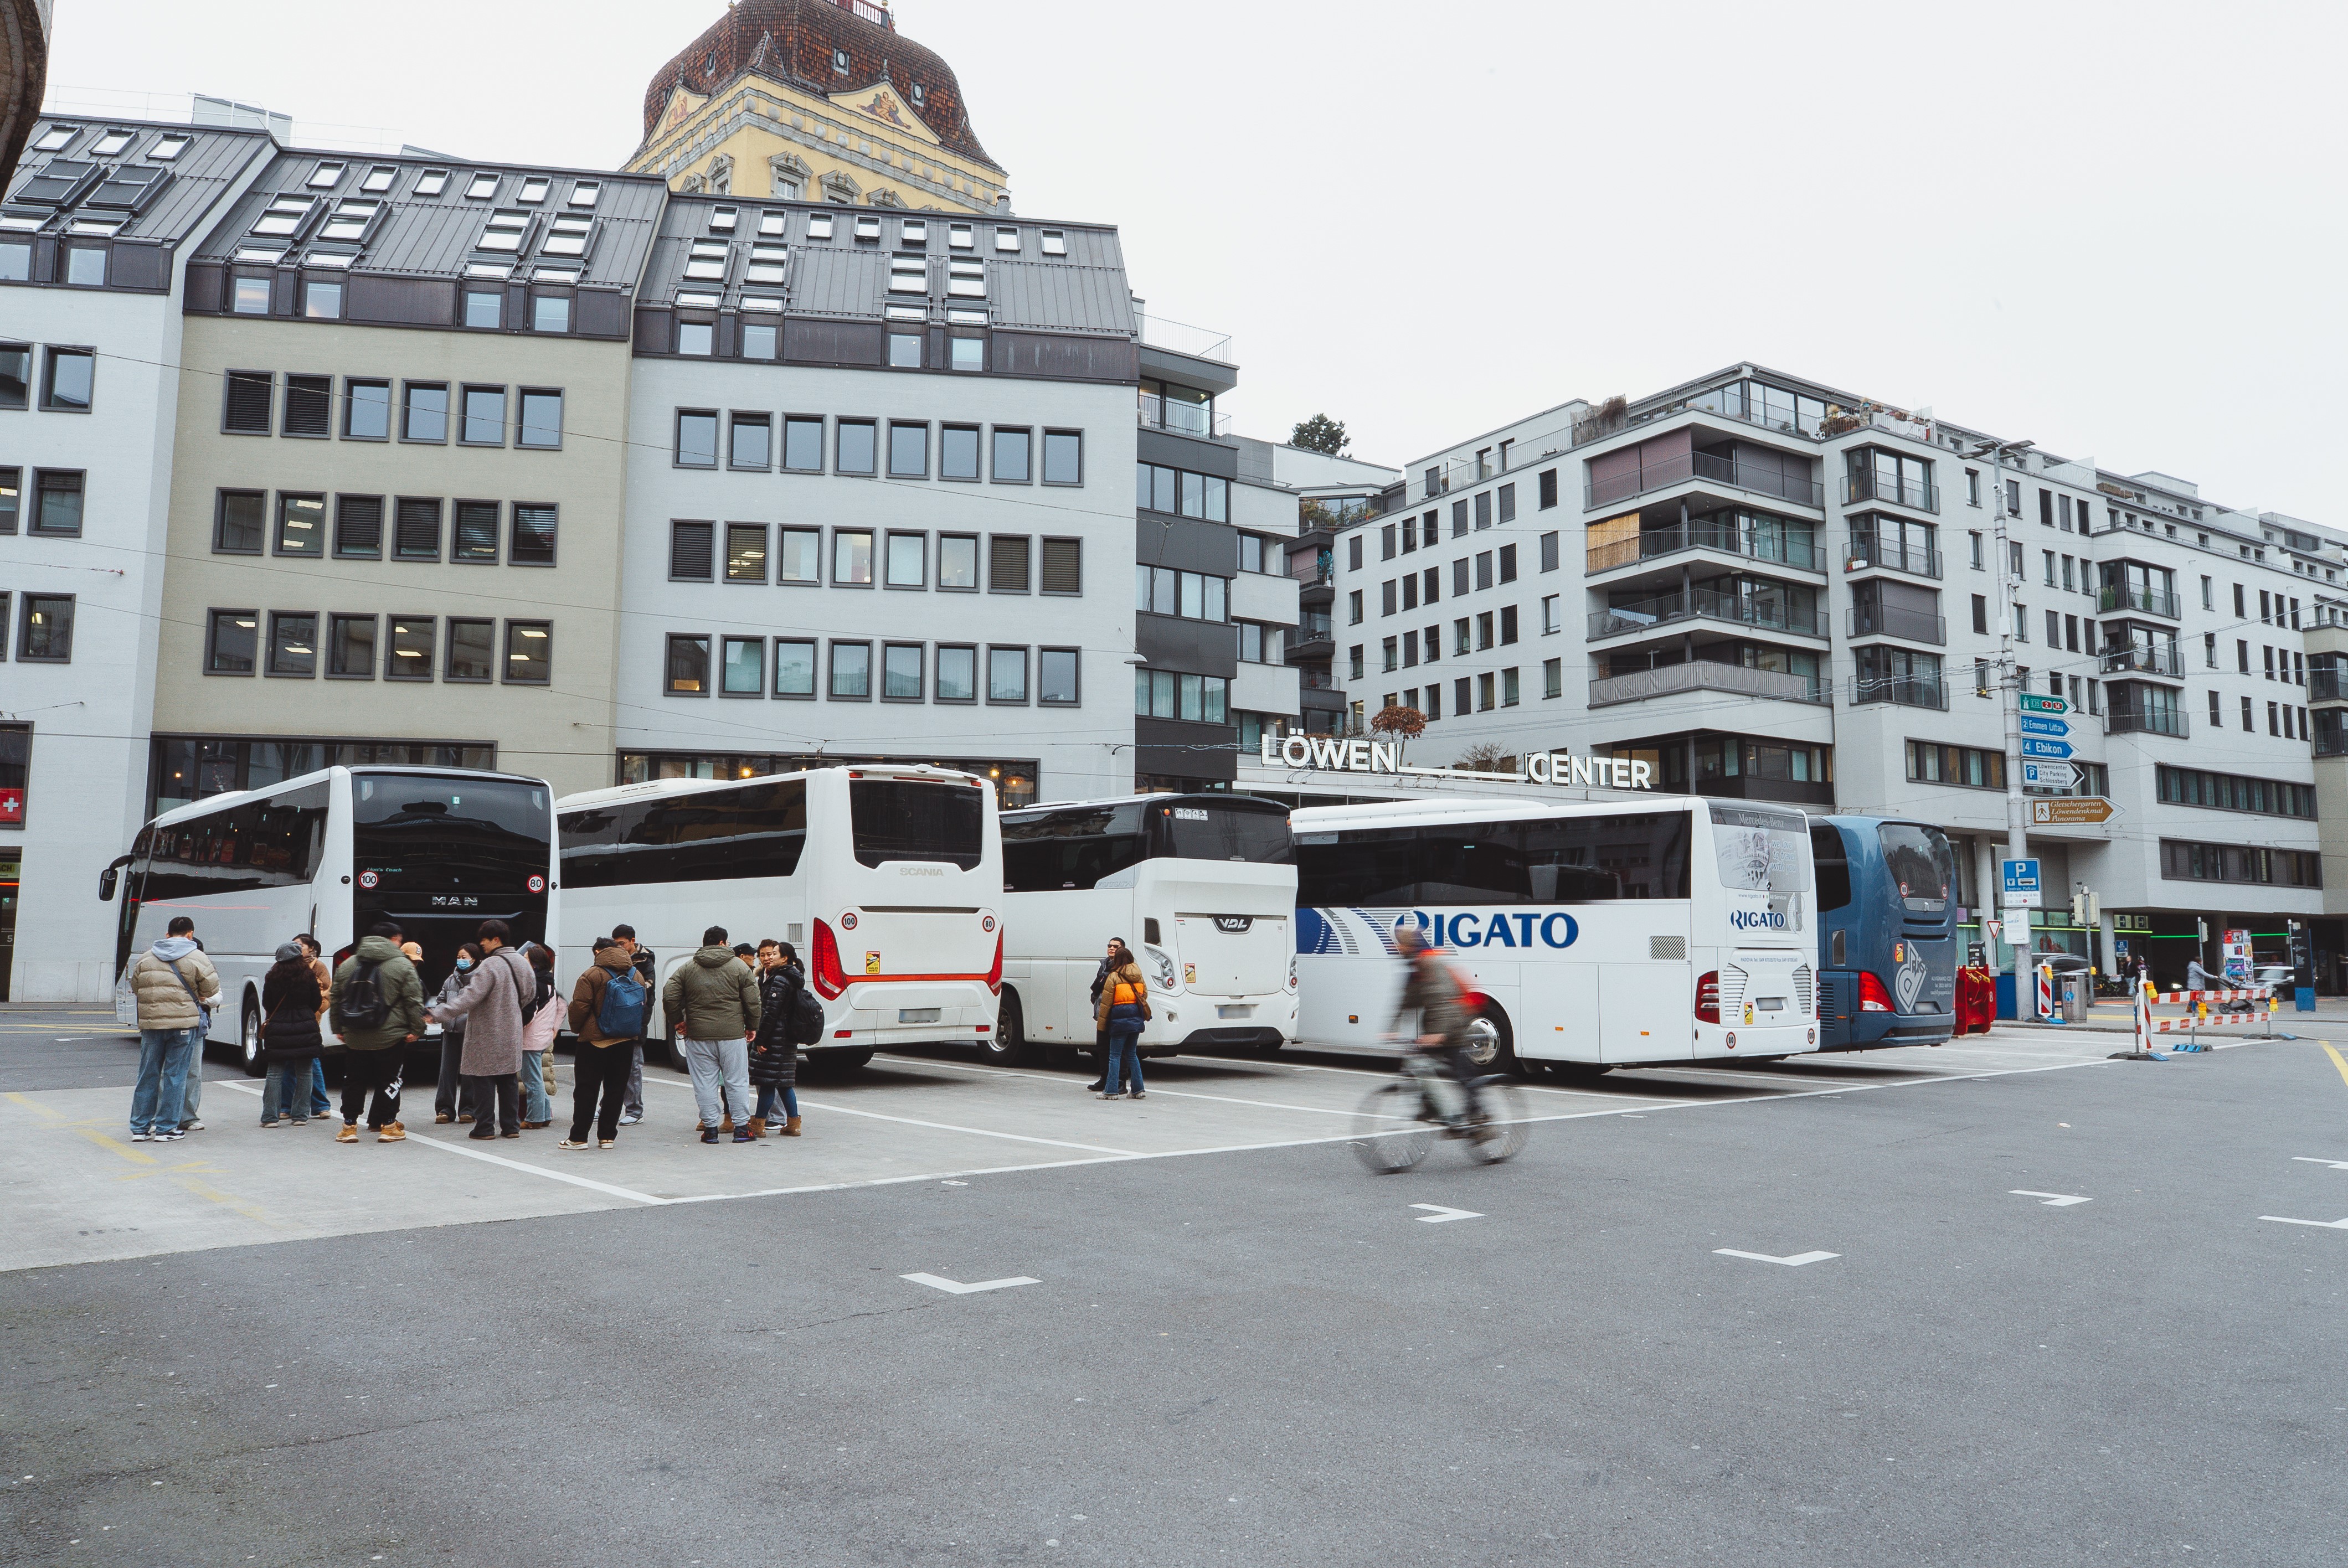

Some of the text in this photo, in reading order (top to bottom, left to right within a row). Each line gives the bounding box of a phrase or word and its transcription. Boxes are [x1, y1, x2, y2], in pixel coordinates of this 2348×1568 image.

[2029, 720, 2047, 730] Emmen
[2049, 722, 2063, 732] Littau
[2025, 742, 2062, 754] 4 Ebikon
[1261, 728, 1651, 789] LÖWEN CENTER
[1738, 813, 1784, 828] Mercedes-Benz
[899, 868, 944, 876] SCANIA
[2015, 863, 2026, 878] P
[362, 875, 377, 884] 100
[530, 879, 542, 888] 80
[432, 896, 478, 905] MAN
[1219, 919, 1248, 929] VDL
[1731, 910, 1784, 930] RIGATO
